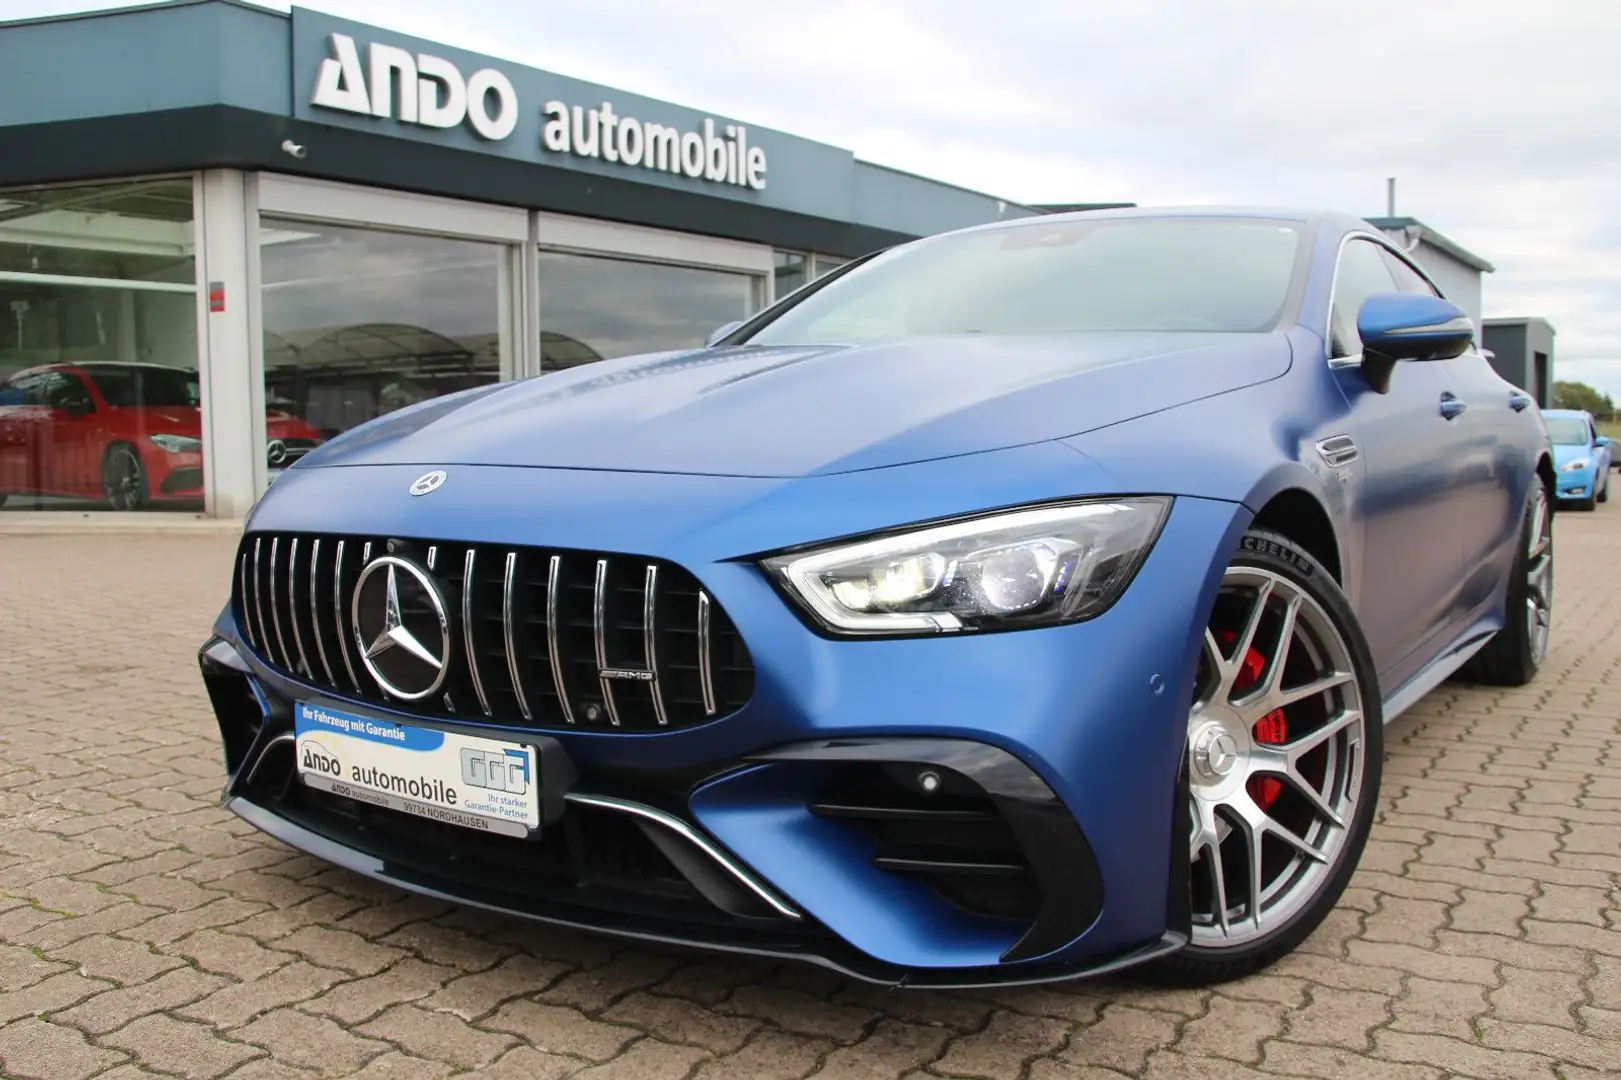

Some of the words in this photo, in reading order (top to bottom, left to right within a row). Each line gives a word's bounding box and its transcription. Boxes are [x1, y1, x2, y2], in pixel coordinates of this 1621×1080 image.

[309, 32, 519, 142] ANDO
[540, 99, 767, 190] automobile
[302, 706, 313, 720] Ihr
[314, 710, 350, 732] Fahrzeug
[351, 720, 366, 733] mit
[366, 722, 406, 741] Garantie
[352, 764, 458, 805] automobile
[488, 793, 499, 803] Ihr
[500, 796, 528, 809] starker
[351, 788, 390, 807] automobile
[427, 807, 489, 830] NORDHAUSEN
[464, 799, 529, 820] Garantie-Partner
